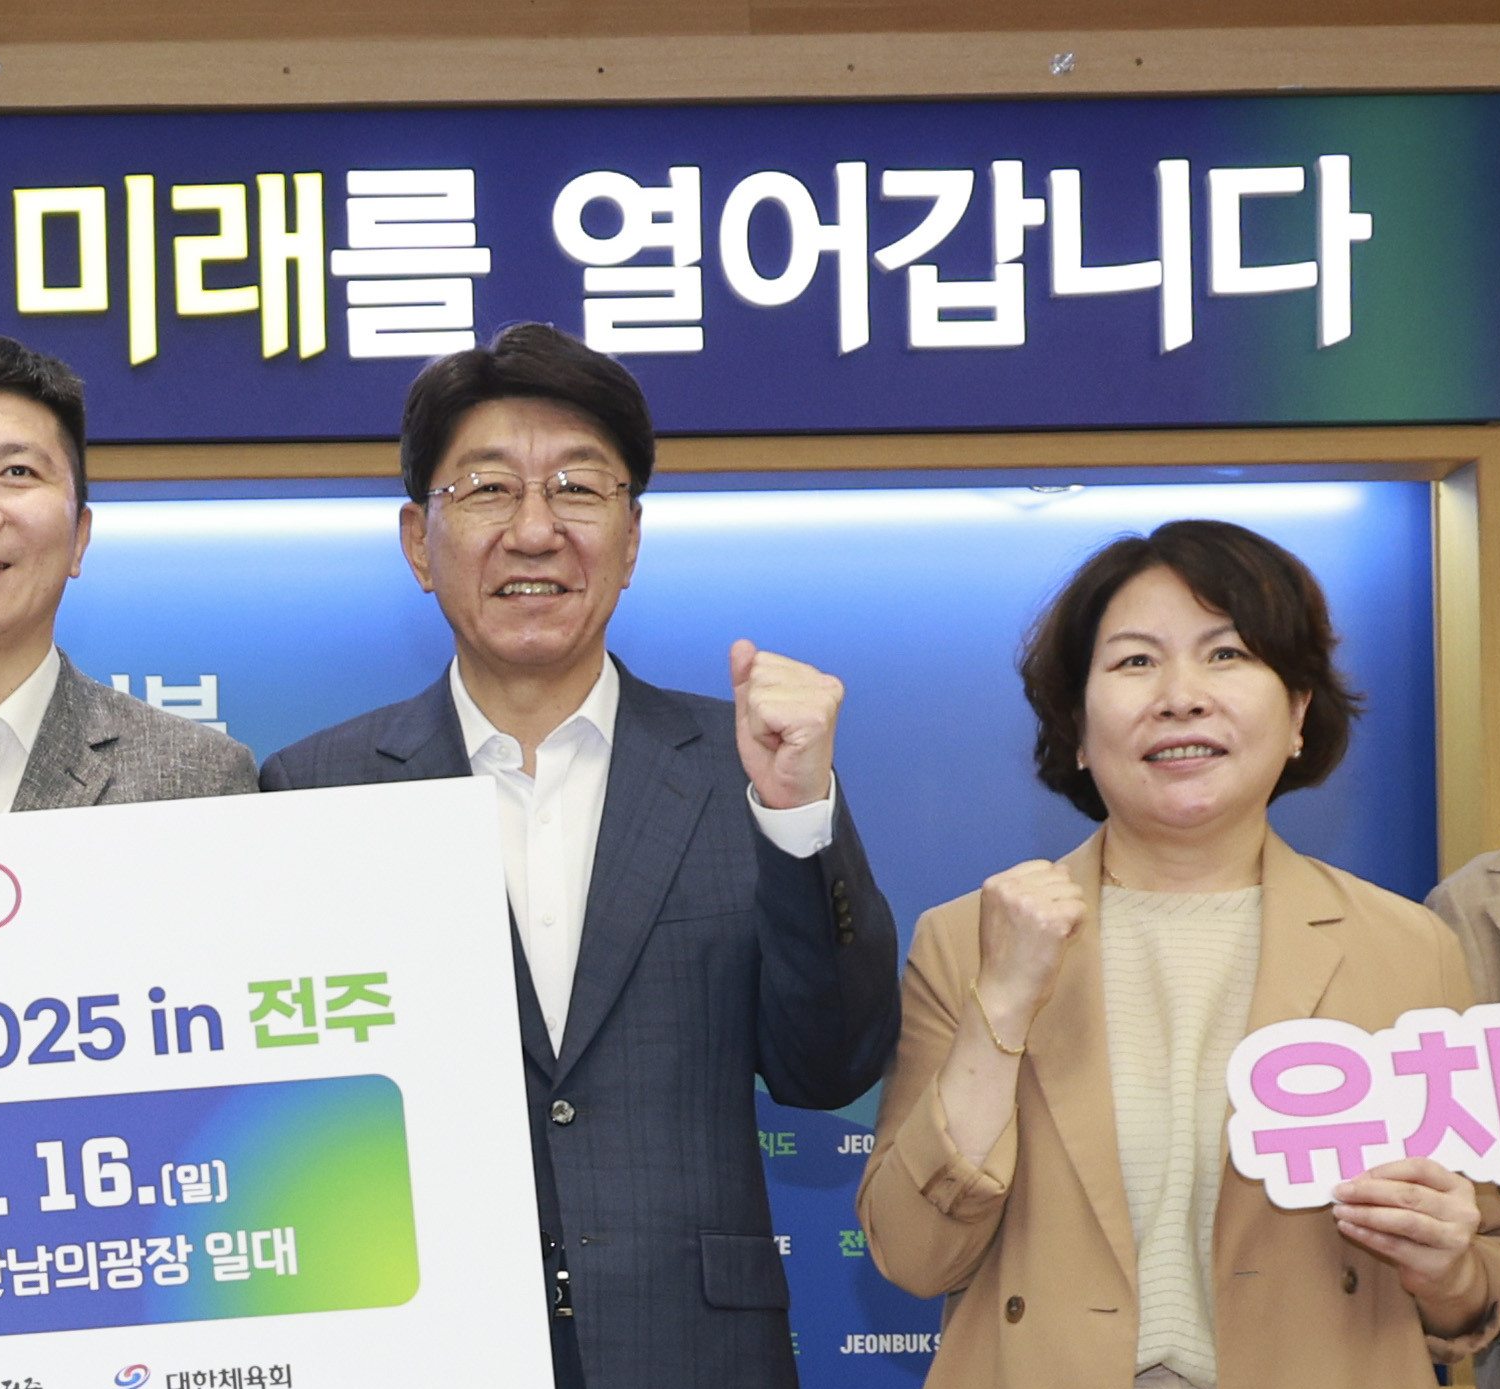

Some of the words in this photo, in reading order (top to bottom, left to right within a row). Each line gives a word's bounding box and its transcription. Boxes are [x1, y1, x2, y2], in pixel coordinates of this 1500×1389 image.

[13, 169, 491, 365] 미래를
[552, 154, 1373, 355] 열어갑니다
[147, 986, 225, 1056] in
[247, 971, 396, 1049] 전주
[205, 1226, 298, 1282] 일대
[839, 1333, 933, 1354] JEONBUK
